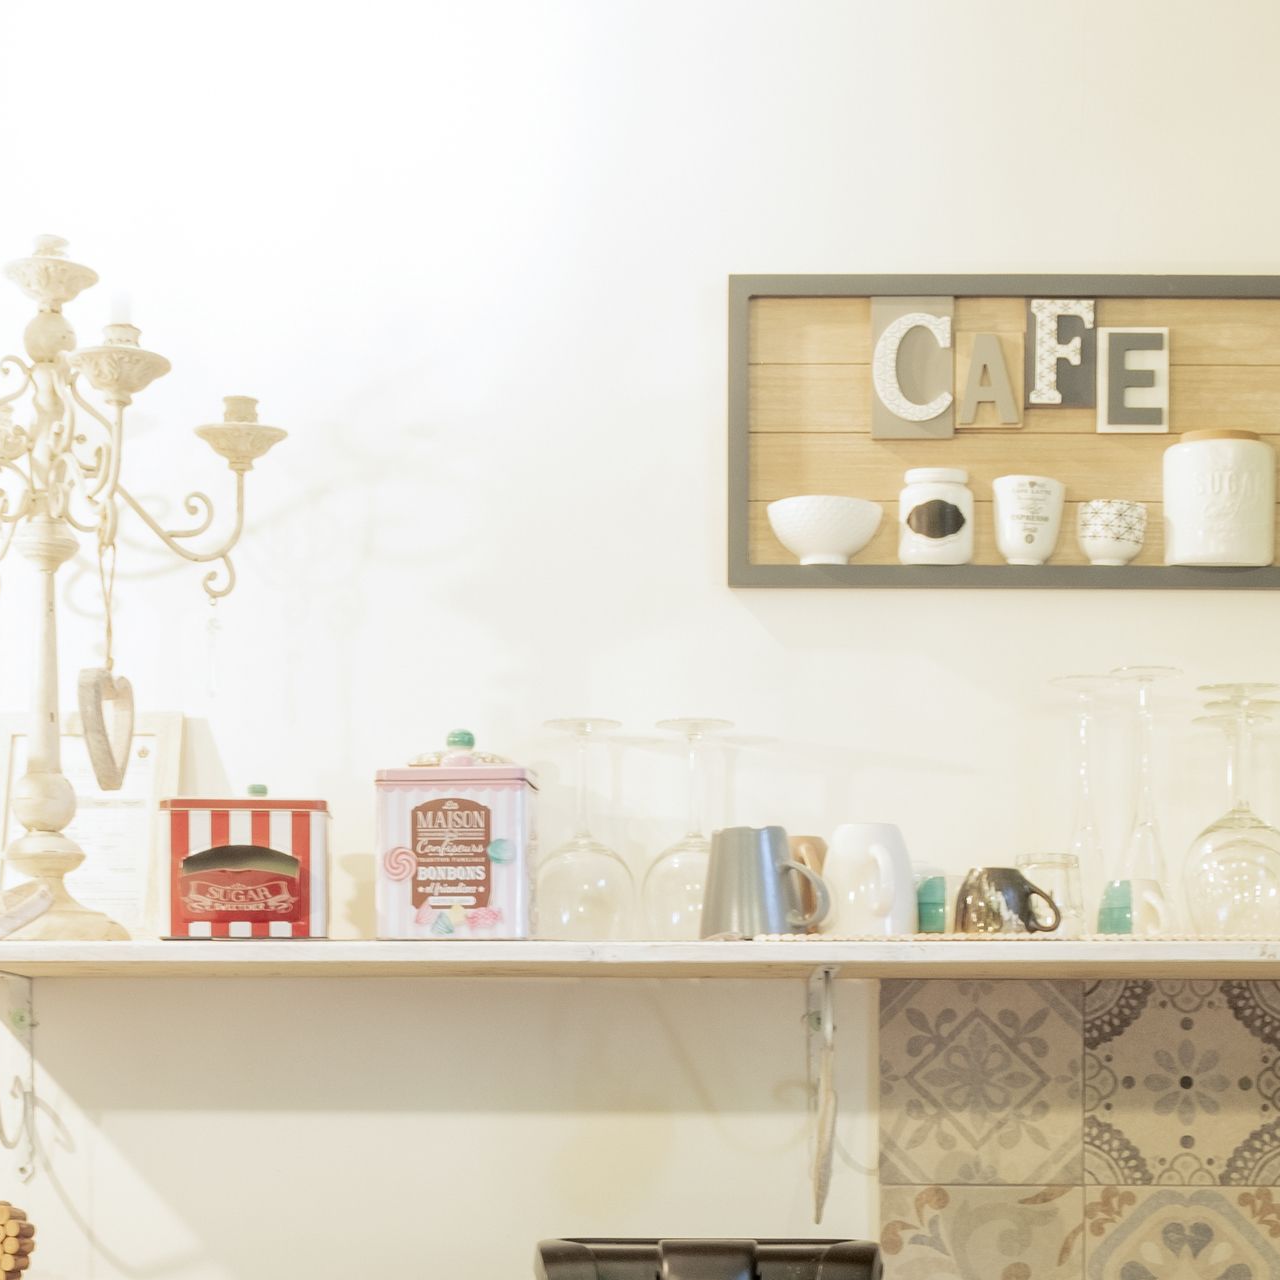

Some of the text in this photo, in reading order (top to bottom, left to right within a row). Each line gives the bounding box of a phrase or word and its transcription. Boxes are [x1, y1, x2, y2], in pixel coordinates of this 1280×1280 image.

[872, 298, 1164, 426] CAFE
[416, 811, 485, 828] MAISON
[417, 866, 487, 881] BONBONS
[206, 886, 272, 902] SUGAR
